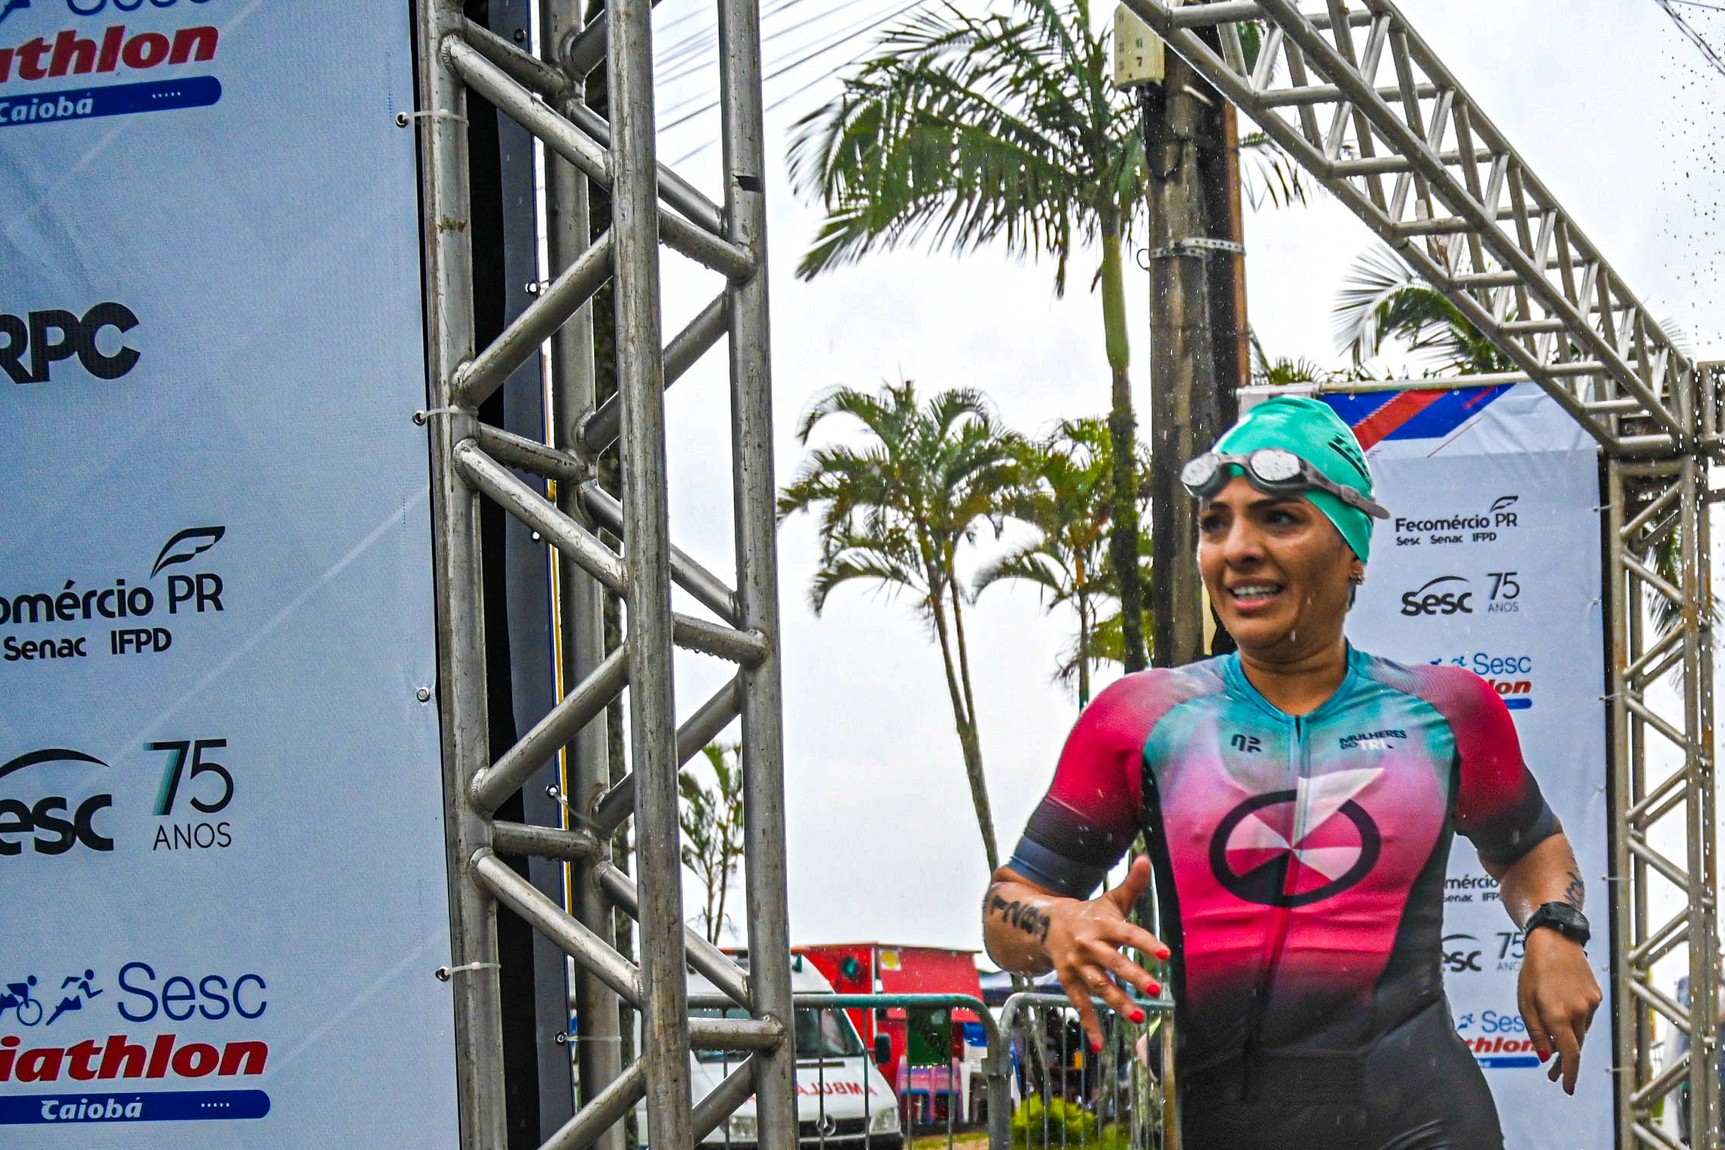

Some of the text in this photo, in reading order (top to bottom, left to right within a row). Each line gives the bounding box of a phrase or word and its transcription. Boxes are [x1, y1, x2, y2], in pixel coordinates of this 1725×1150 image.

[1395, 512, 1518, 533] Fecomércio PR
[1396, 531, 1497, 546] Sesc Senac IFPD
[167, 572, 226, 615] PR
[1486, 571, 1520, 601] 75
[1487, 601, 1519, 614] ANOS
[3, 627, 173, 662] Senac IFPD
[1473, 652, 1532, 676] Sesc
[142, 738, 235, 816] 75
[152, 821, 233, 851] ANOS
[1482, 891, 1501, 902] IFP
[116, 961, 268, 1023] Sesc
[41, 1095, 144, 1121] Caiobá
